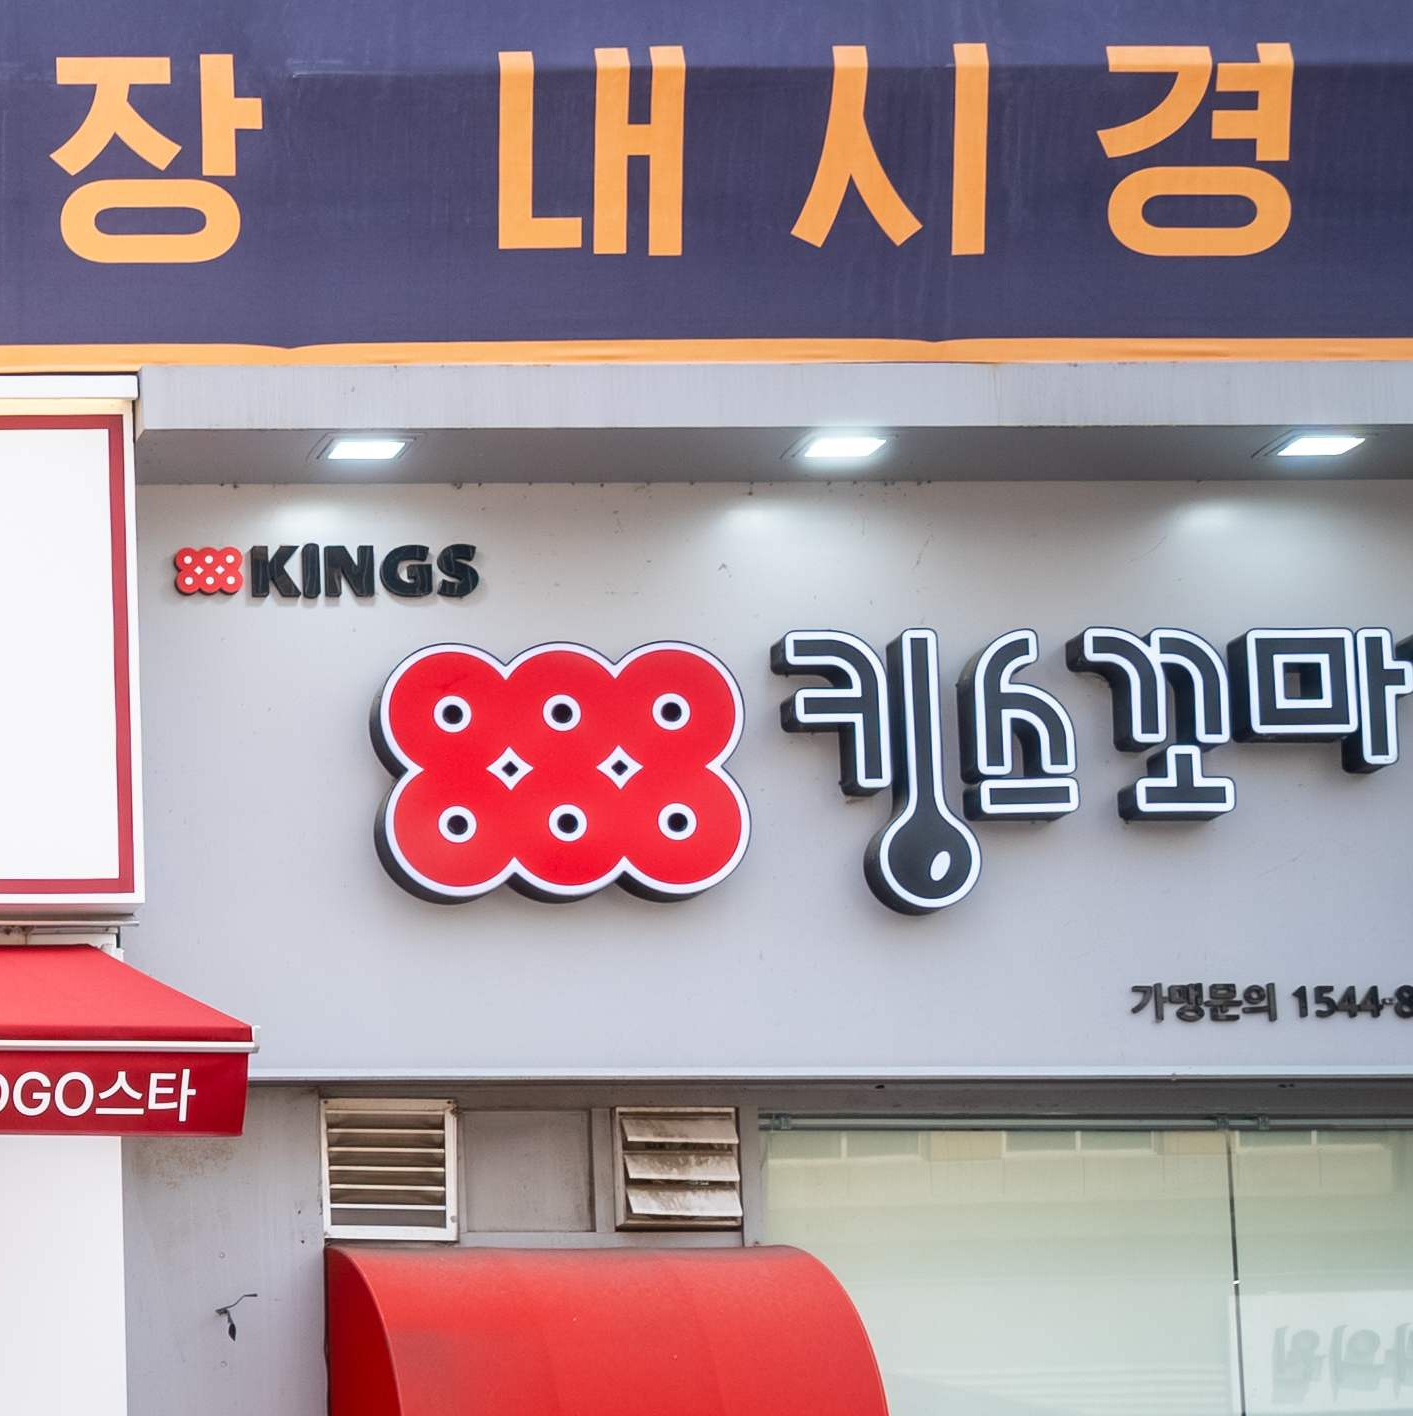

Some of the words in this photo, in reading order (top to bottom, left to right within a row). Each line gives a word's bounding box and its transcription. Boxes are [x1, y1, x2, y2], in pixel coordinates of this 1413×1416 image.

[499, 42, 1295, 257] 내시경
[248, 543, 480, 600] KINGS
[1130, 982, 1279, 1022] 가맹문의
